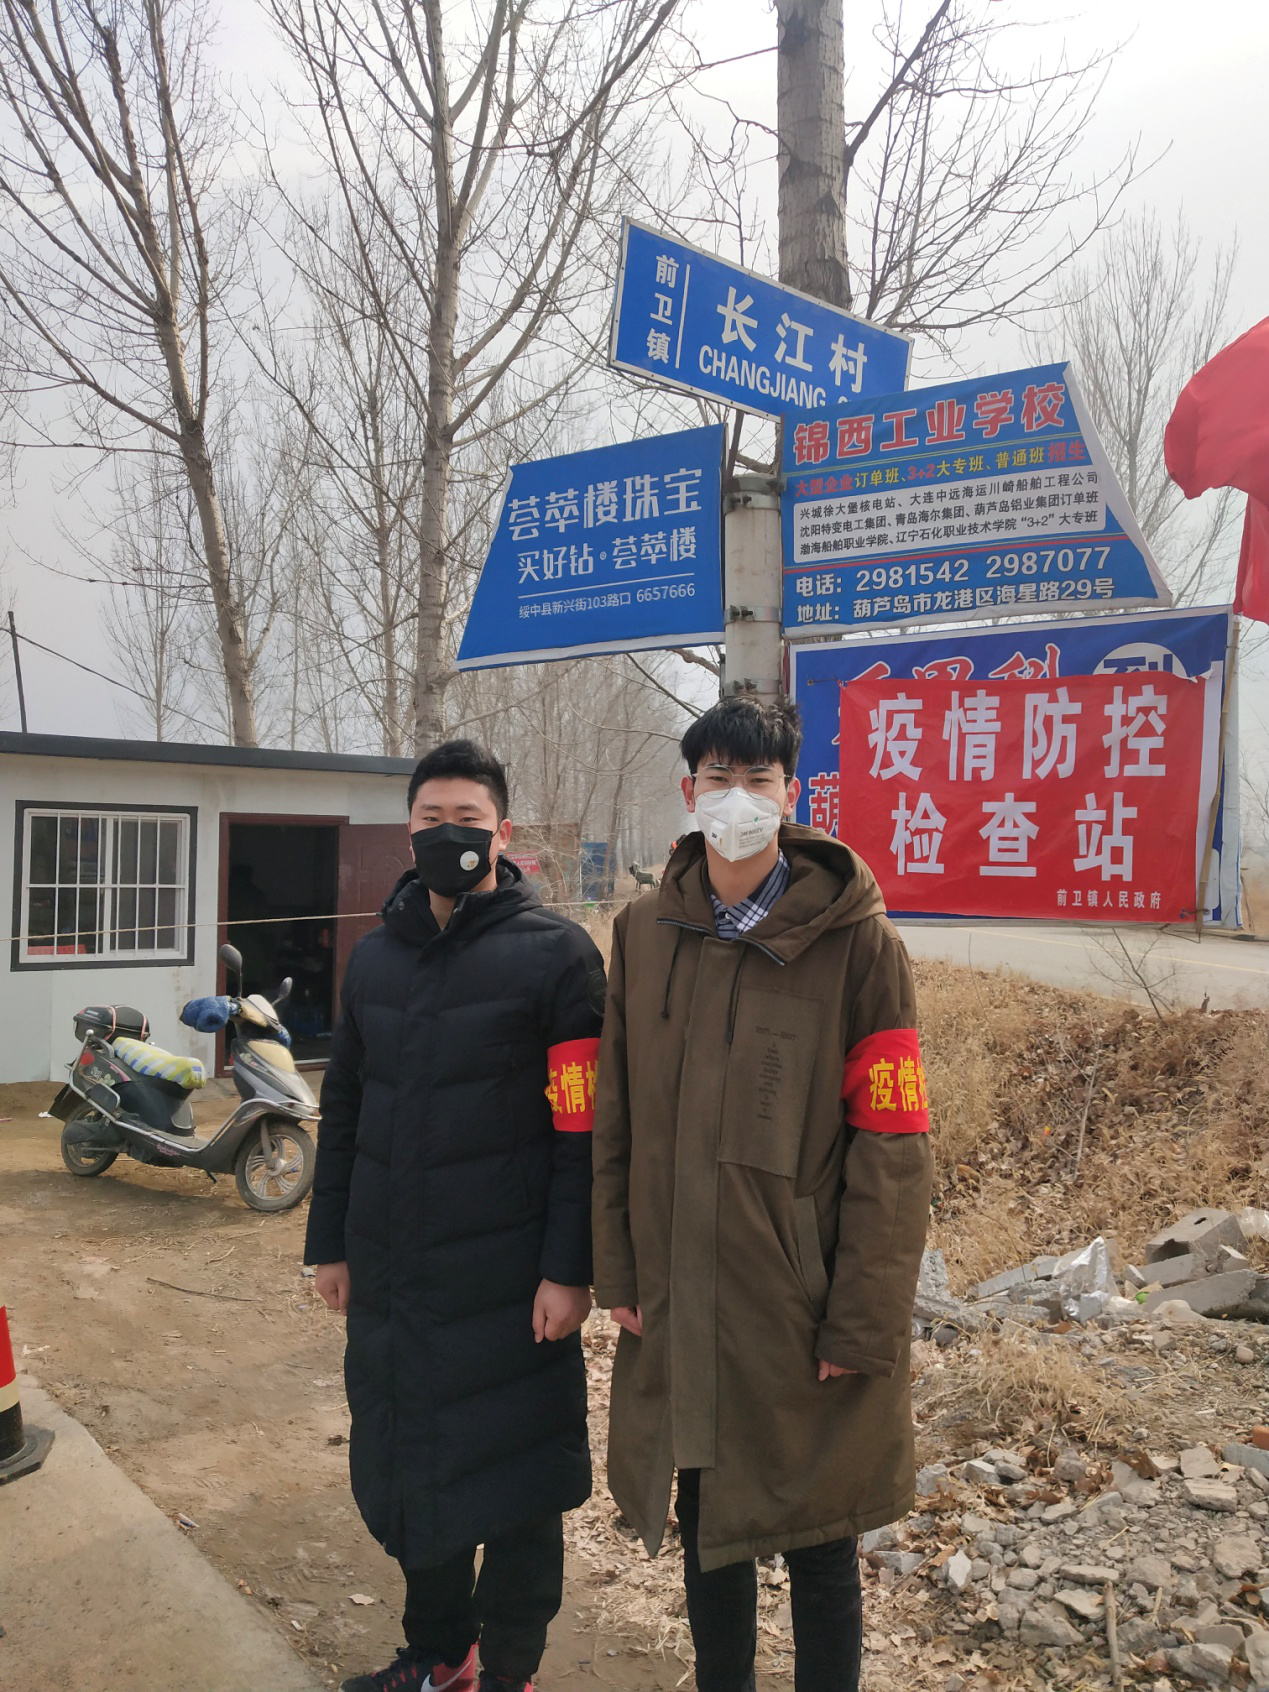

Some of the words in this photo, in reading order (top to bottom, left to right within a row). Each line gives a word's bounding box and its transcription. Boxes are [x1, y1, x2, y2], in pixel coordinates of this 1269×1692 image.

[646, 254, 680, 364] 前卫镇
[716, 286, 868, 393] 长江村
[699, 344, 827, 409] CHANGJIANG
[794, 382, 1067, 465] 锦西工业学校
[508, 467, 702, 541] 荟萃楼珠宝
[518, 592, 631, 619] 绥中县新兴街103路口
[636, 582, 696, 603] 6657666
[855, 558, 970, 593] 2981542
[985, 545, 1112, 579] 2987077
[867, 684, 1169, 783] 疫情防控
[889, 791, 1139, 883] 检查站
[1056, 888, 1162, 910] 前卫镇人民政府
